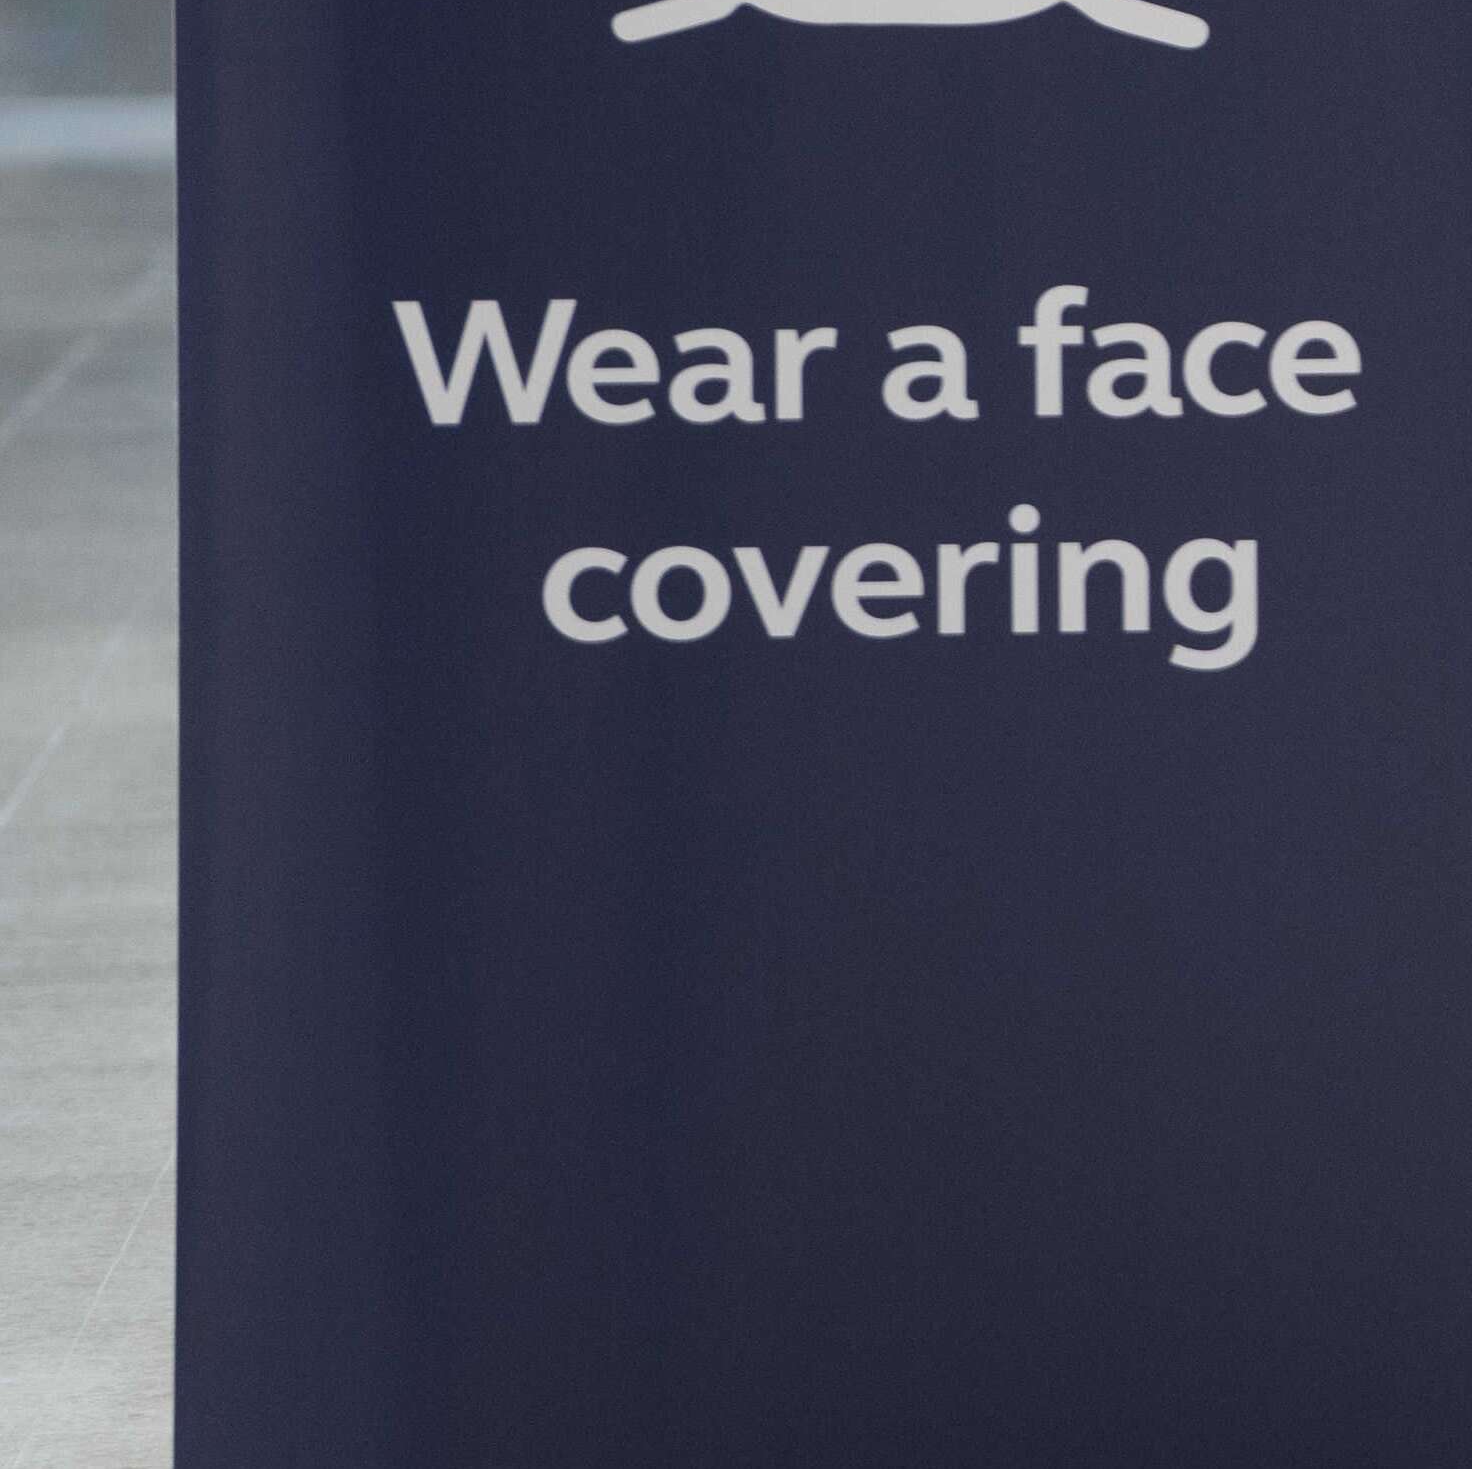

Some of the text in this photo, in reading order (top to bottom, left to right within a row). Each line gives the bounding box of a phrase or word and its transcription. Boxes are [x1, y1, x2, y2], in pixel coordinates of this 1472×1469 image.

[392, 284, 1363, 426] Wear a face
[542, 503, 1260, 671] covering
